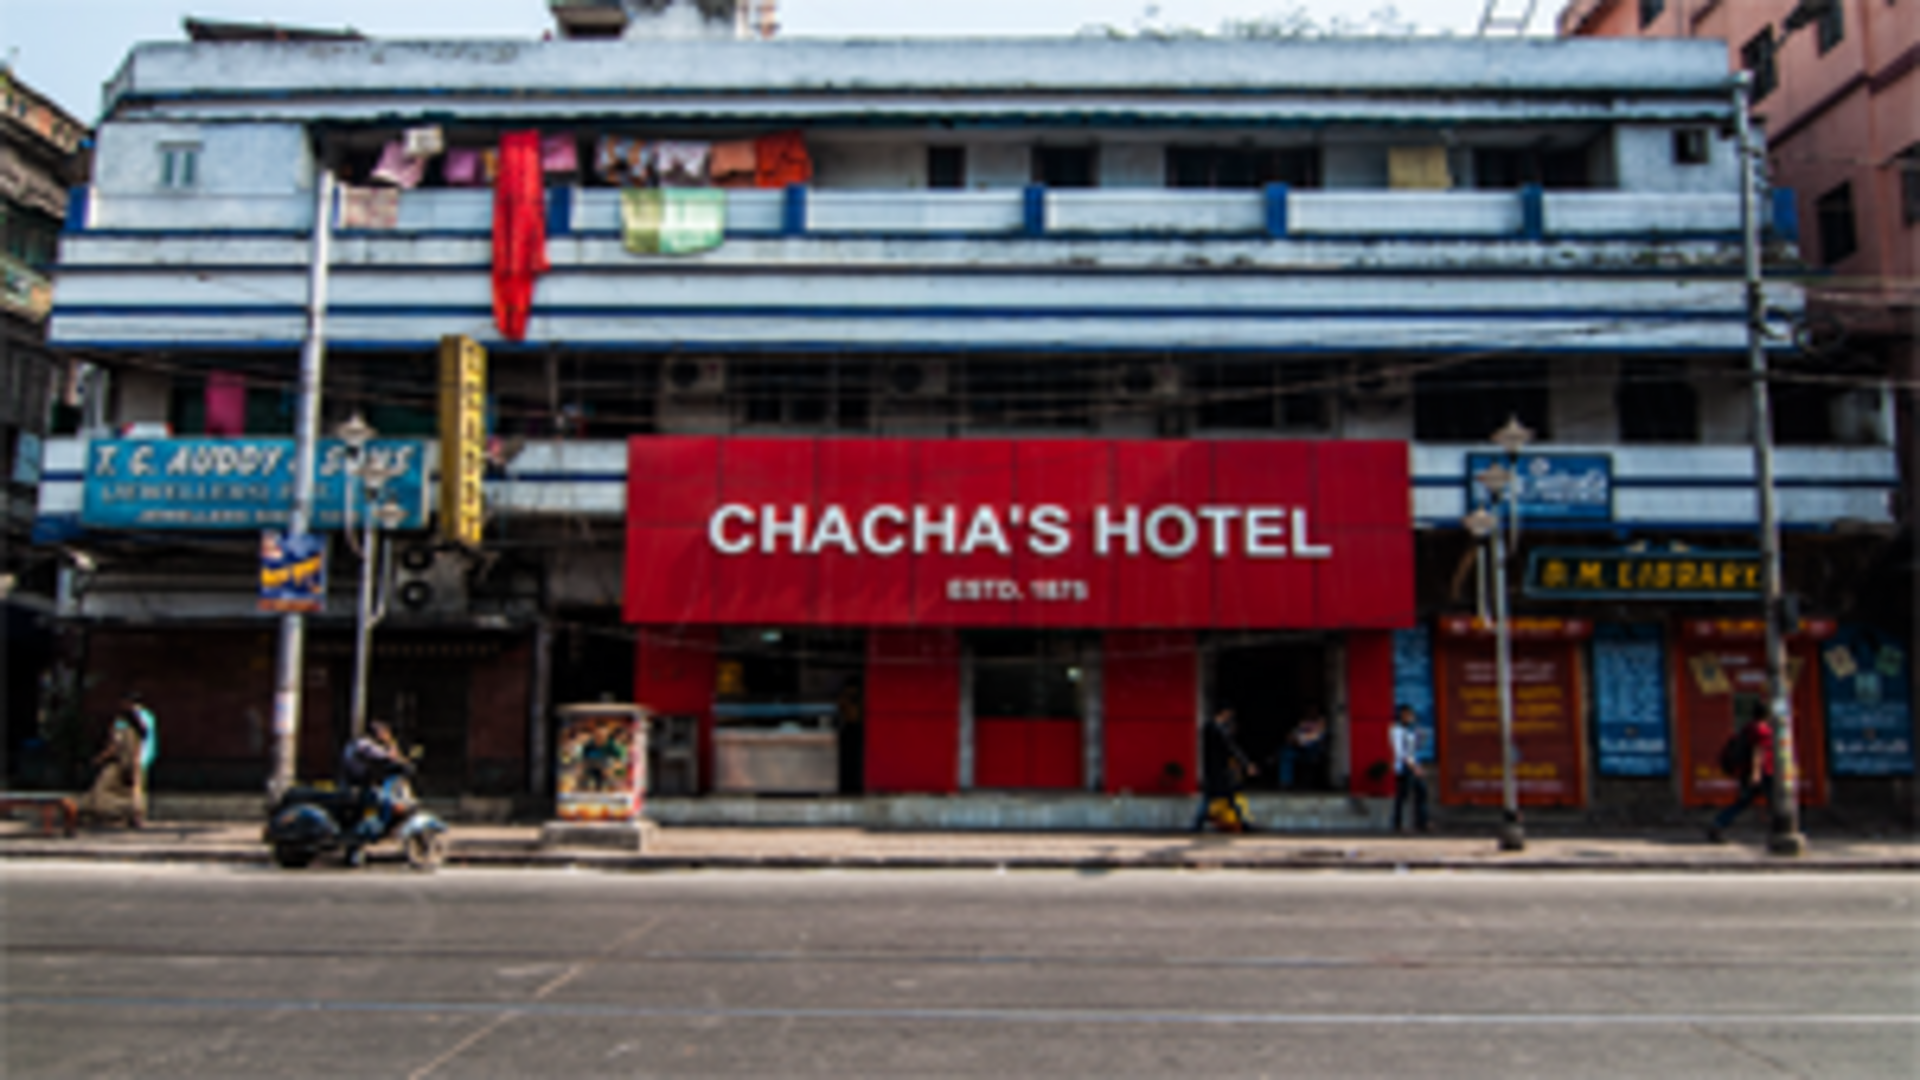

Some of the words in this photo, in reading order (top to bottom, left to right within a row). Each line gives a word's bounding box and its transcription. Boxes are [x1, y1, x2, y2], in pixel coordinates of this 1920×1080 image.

[166, 446, 283, 475] AUDDY
[709, 504, 1071, 556] CHACHA'S
[1094, 506, 1332, 559] HOTEL
[947, 579, 1024, 600] ESTD.
